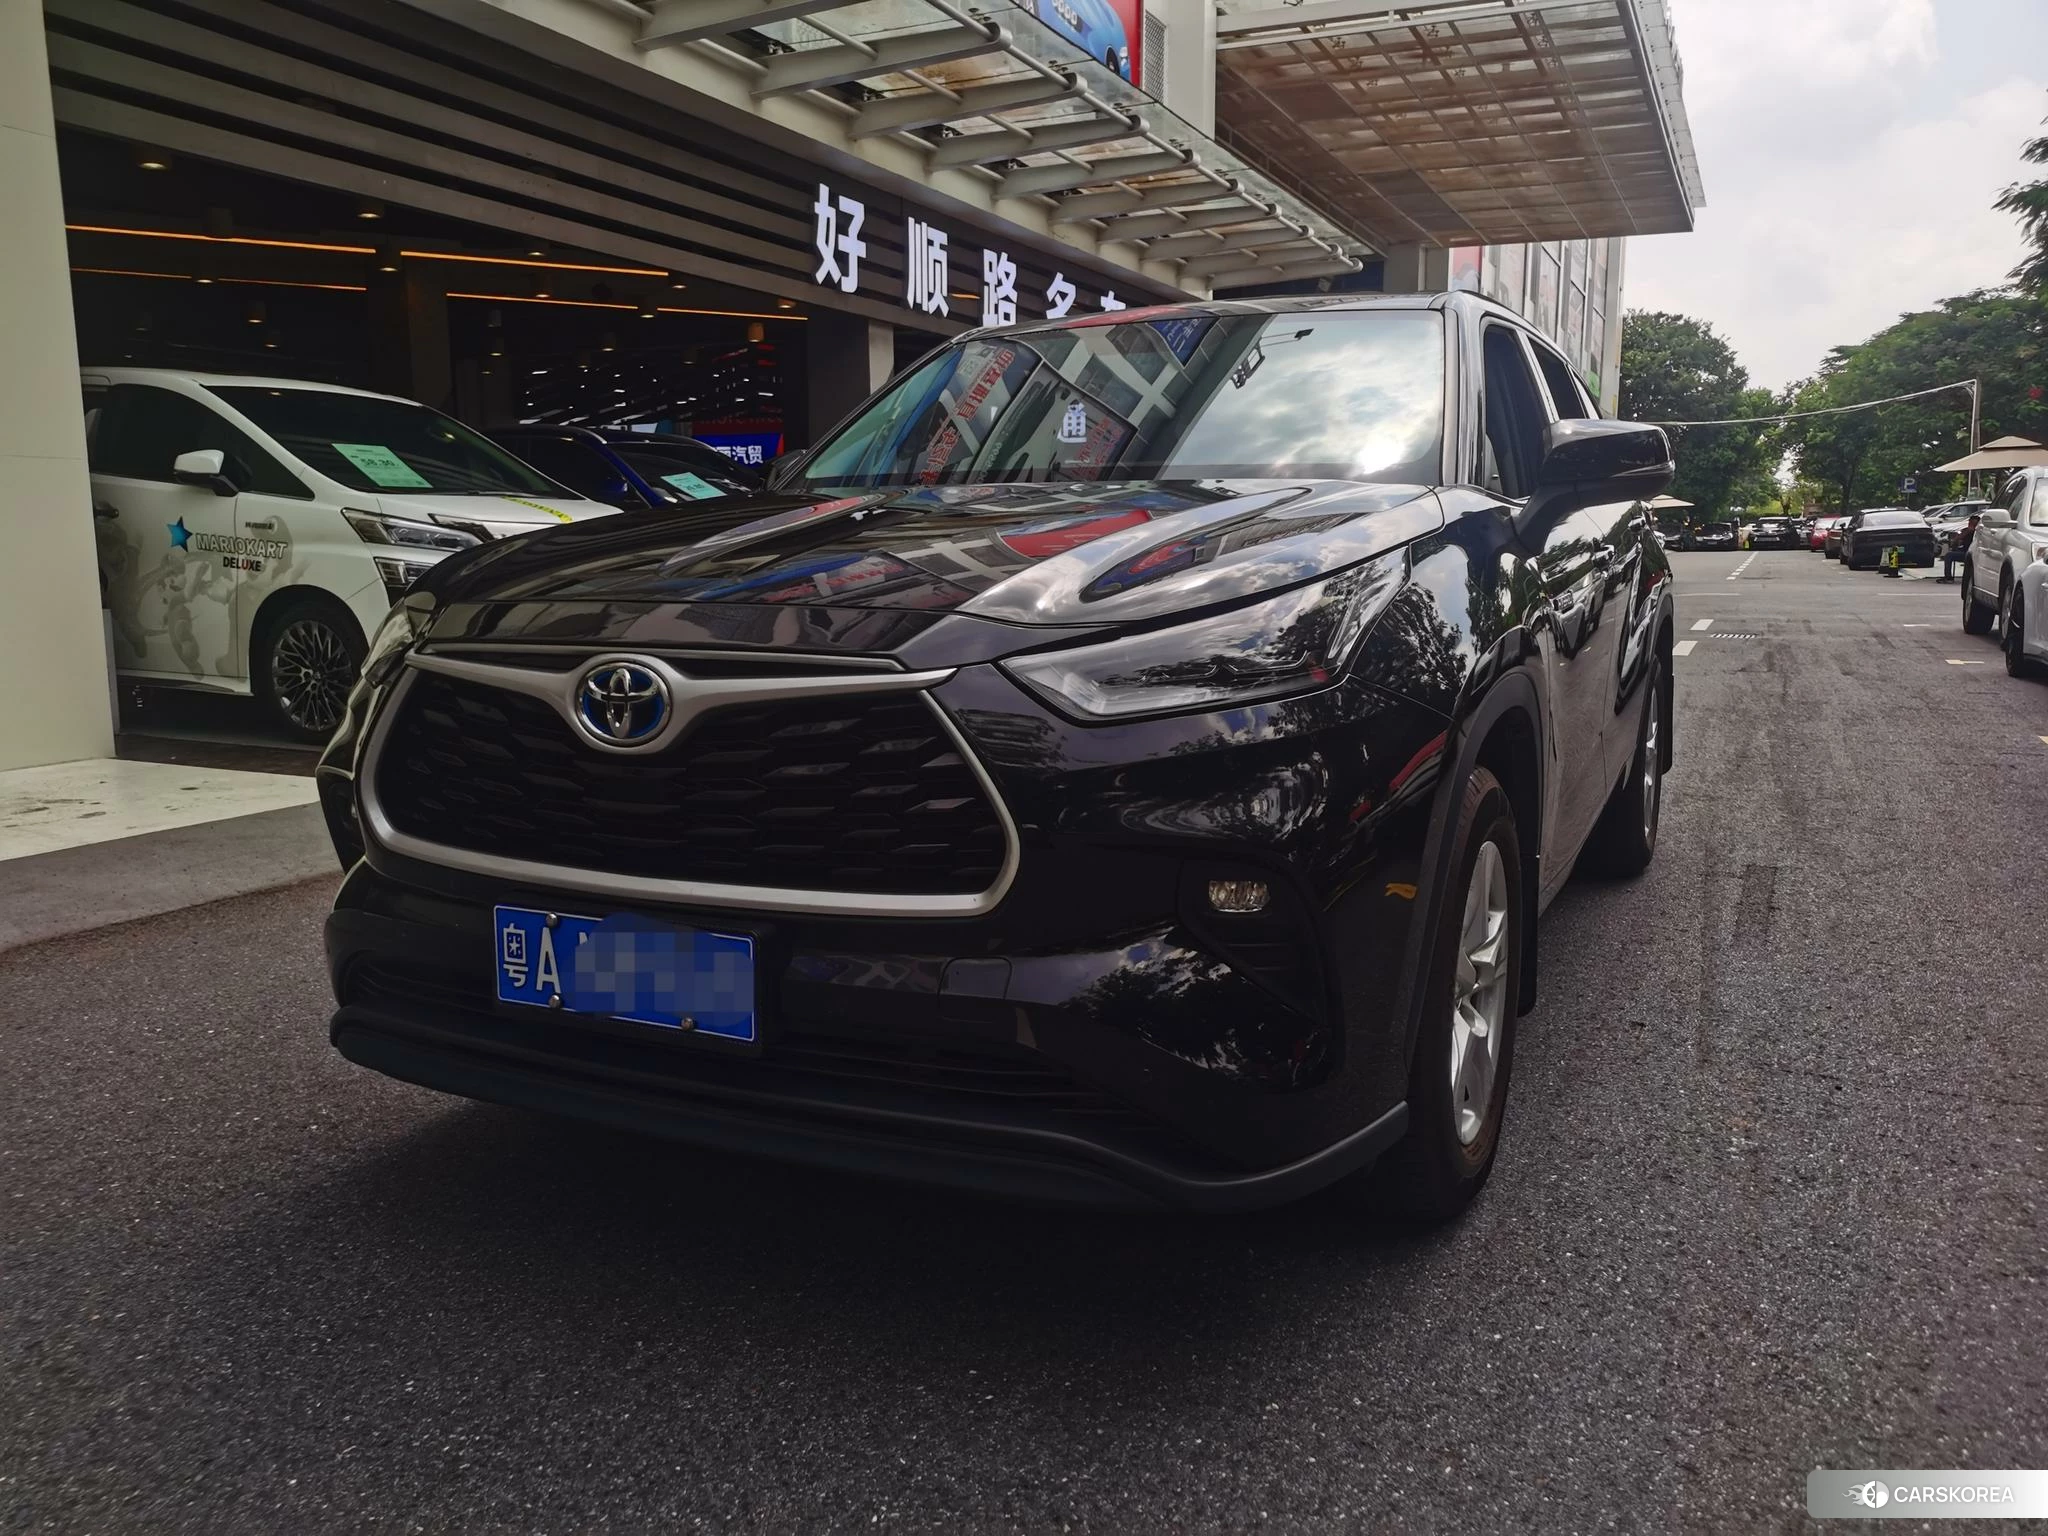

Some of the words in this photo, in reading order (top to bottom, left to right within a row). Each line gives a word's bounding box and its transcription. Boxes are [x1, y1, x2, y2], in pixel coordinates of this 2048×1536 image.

[1903, 478, 1916, 490] P
[195, 533, 288, 560] MARIOKART
[222, 556, 262, 572] DELUXE
